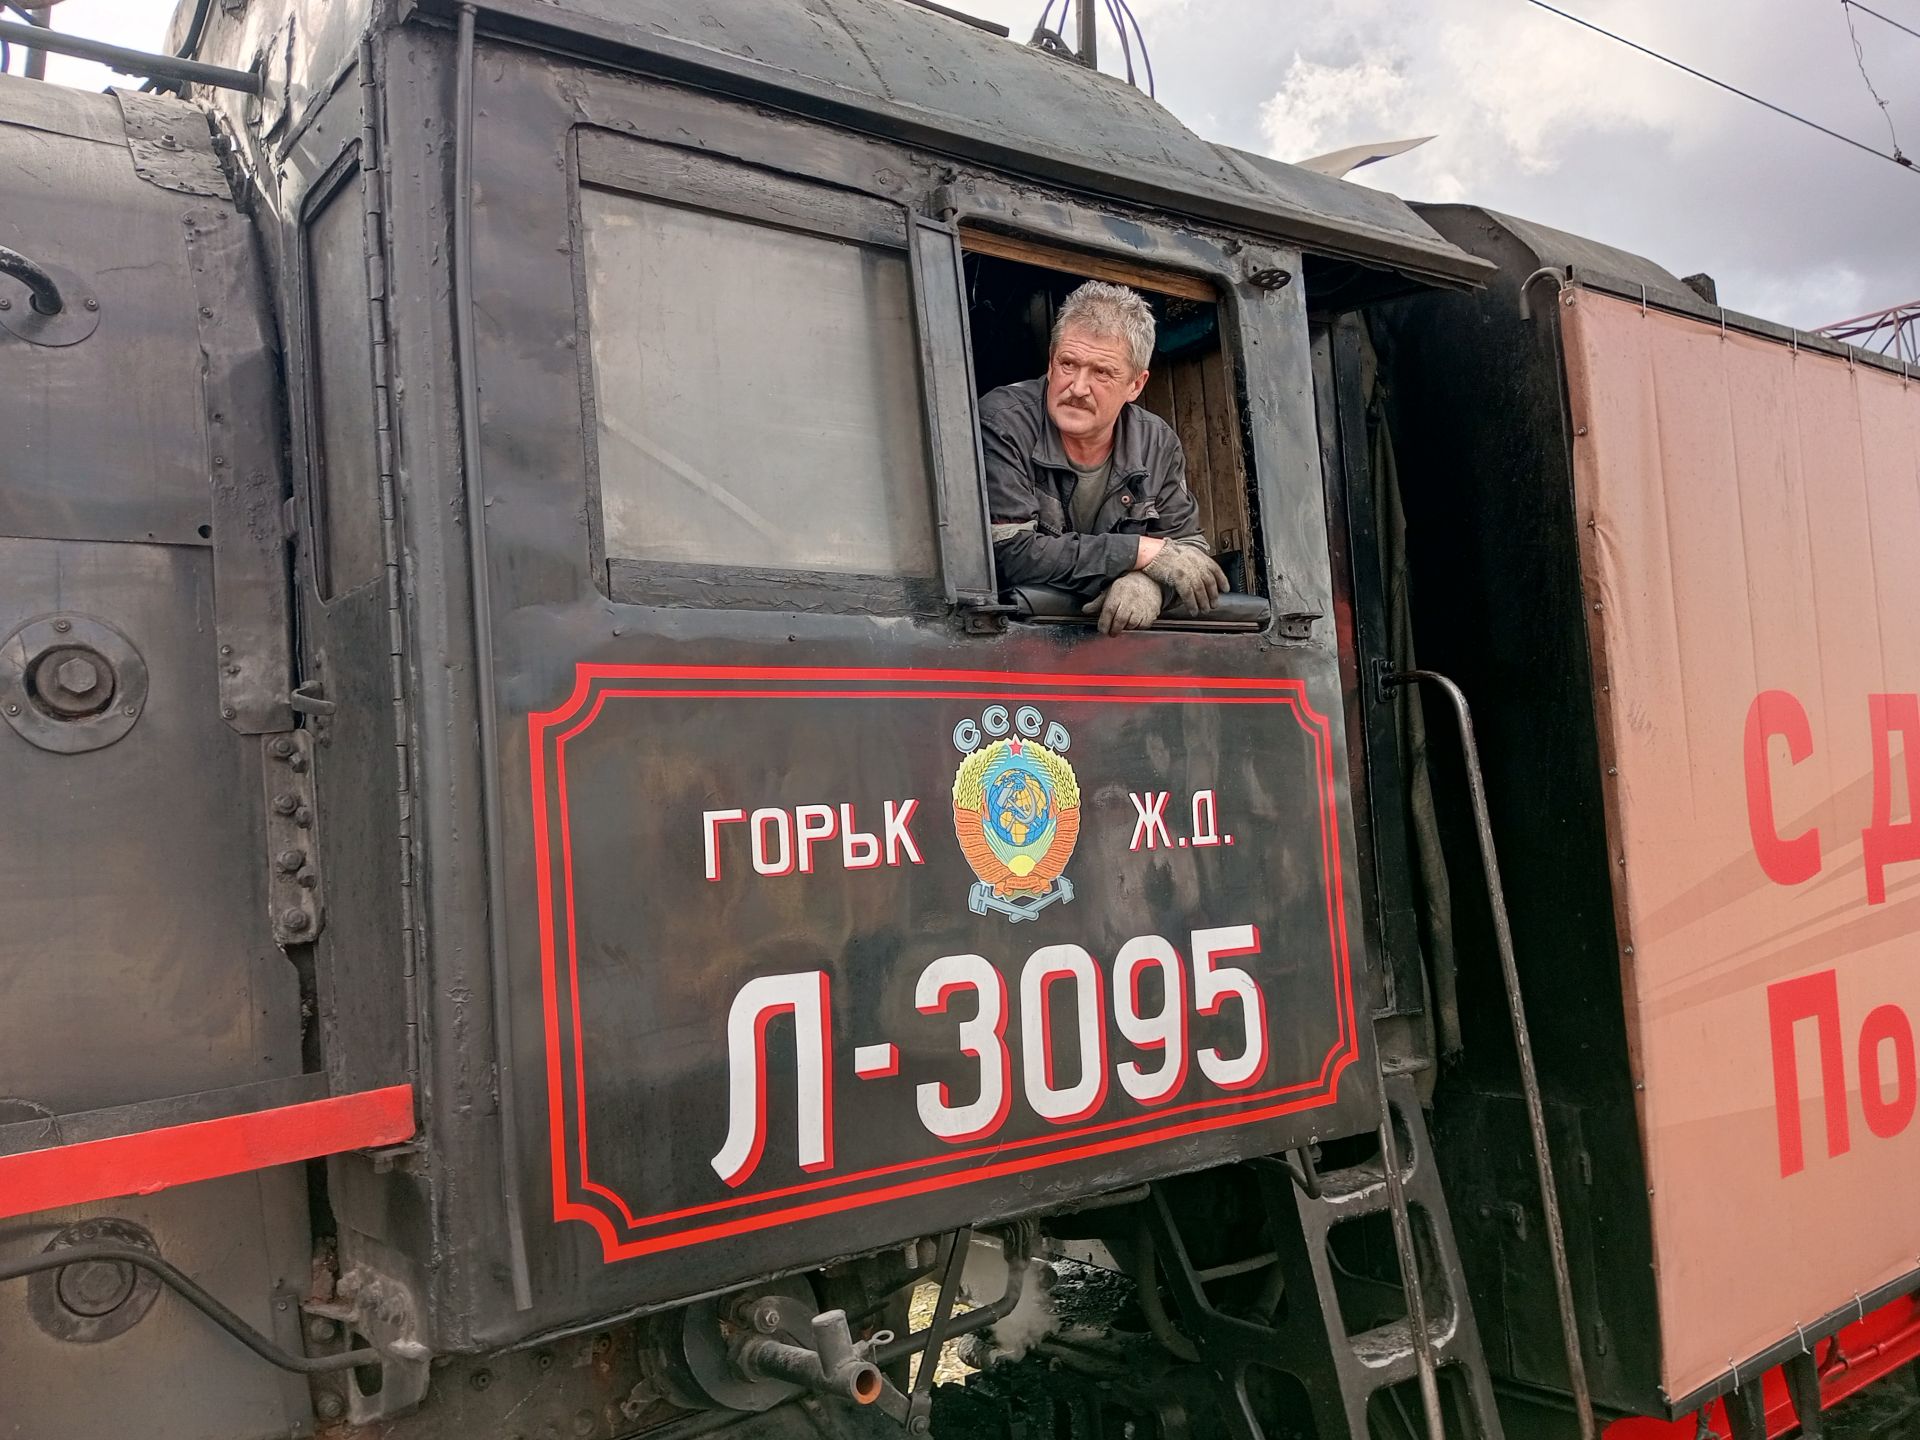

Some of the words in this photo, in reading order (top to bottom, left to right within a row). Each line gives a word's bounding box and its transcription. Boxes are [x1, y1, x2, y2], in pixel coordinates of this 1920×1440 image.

[953, 705, 1071, 753] СССР
[1743, 690, 1821, 886] С
[703, 799, 925, 881] ГОРЬК
[1128, 789, 1235, 852] Ж.Д.
[711, 924, 1267, 1187] Л-3095
[1766, 969, 1917, 1178] По
